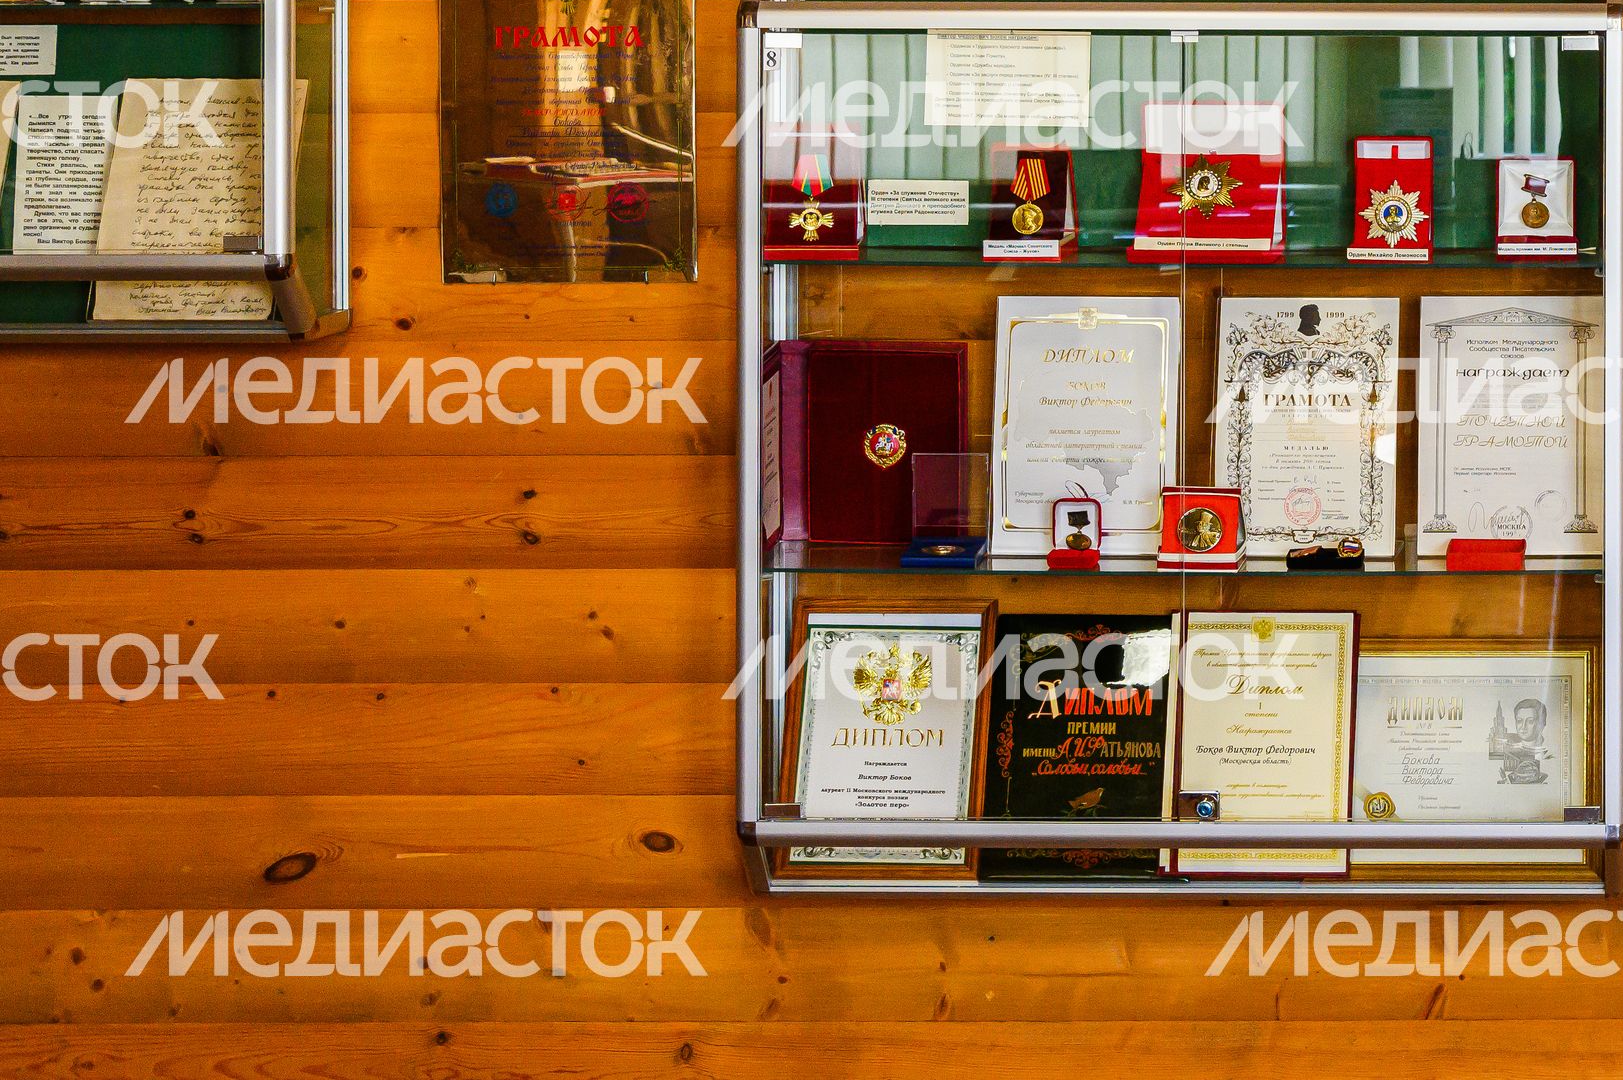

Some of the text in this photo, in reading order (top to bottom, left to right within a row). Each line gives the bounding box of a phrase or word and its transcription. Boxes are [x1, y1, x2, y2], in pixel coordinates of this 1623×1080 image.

[495, 26, 644, 48] ГРАМОТА
[767, 51, 777, 67] 8
[1368, 251, 1393, 259] Михайло
[1042, 348, 1135, 364] ДИПЛОМ
[1456, 368, 1569, 379] награждает
[1039, 397, 1077, 407] Виктор
[1264, 394, 1351, 407] ГРАМОТА
[1226, 675, 1303, 695] Диплом
[1387, 697, 1463, 724] ДИПЛОМ
[1067, 722, 1116, 734] ПРЕМИИ
[1226, 725, 1292, 735] Награждается
[832, 728, 945, 748] ДИПЛОМ
[1023, 748, 1055, 757] ИМЕНИ
[1196, 746, 1315, 756] Боков Виктор Федорович
[1402, 754, 1440, 764] Бокова
[1402, 766, 1442, 776] Виктора
[1402, 776, 1454, 788] Федоровича
